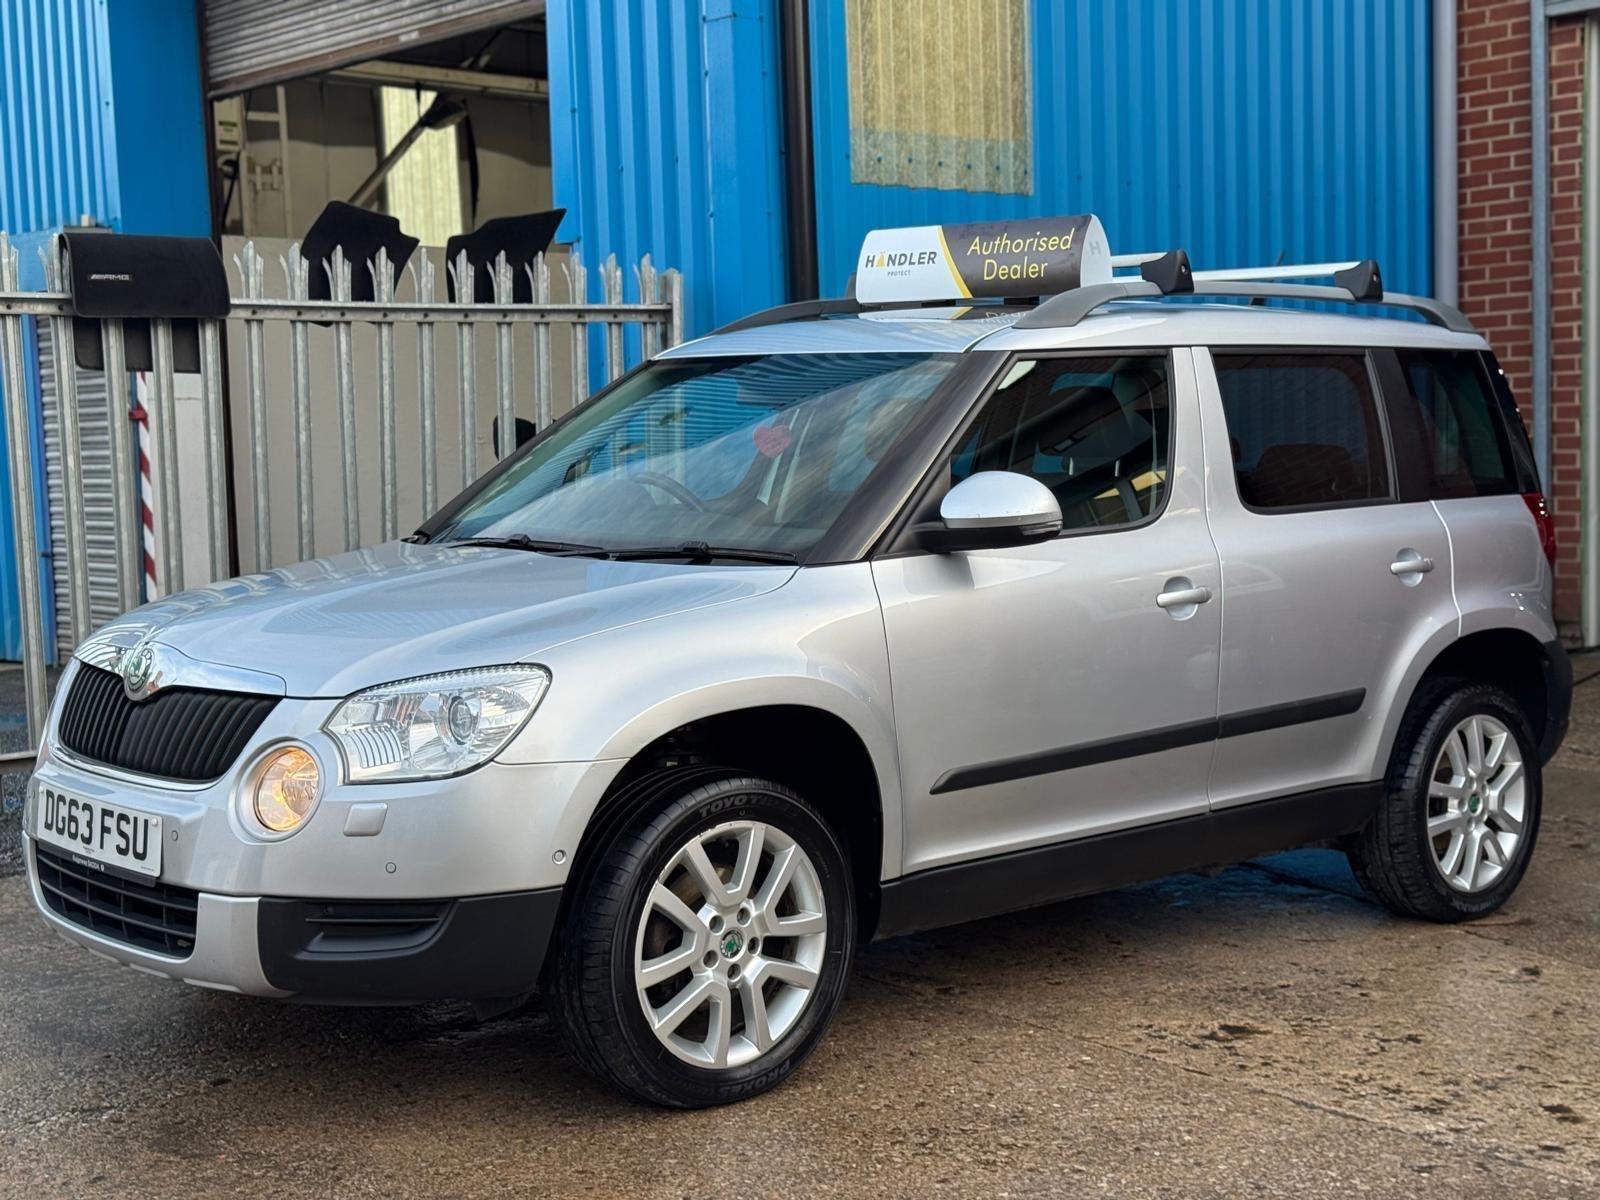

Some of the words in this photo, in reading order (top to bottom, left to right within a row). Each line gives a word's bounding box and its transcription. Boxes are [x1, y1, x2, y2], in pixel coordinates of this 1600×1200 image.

[966, 227, 1075, 256] Authorised
[887, 269, 911, 277] PROTECT
[983, 255, 1048, 280] Dealer
[699, 794, 747, 818] TOYO
[44, 789, 94, 846] DG63
[99, 807, 149, 861] FSU
